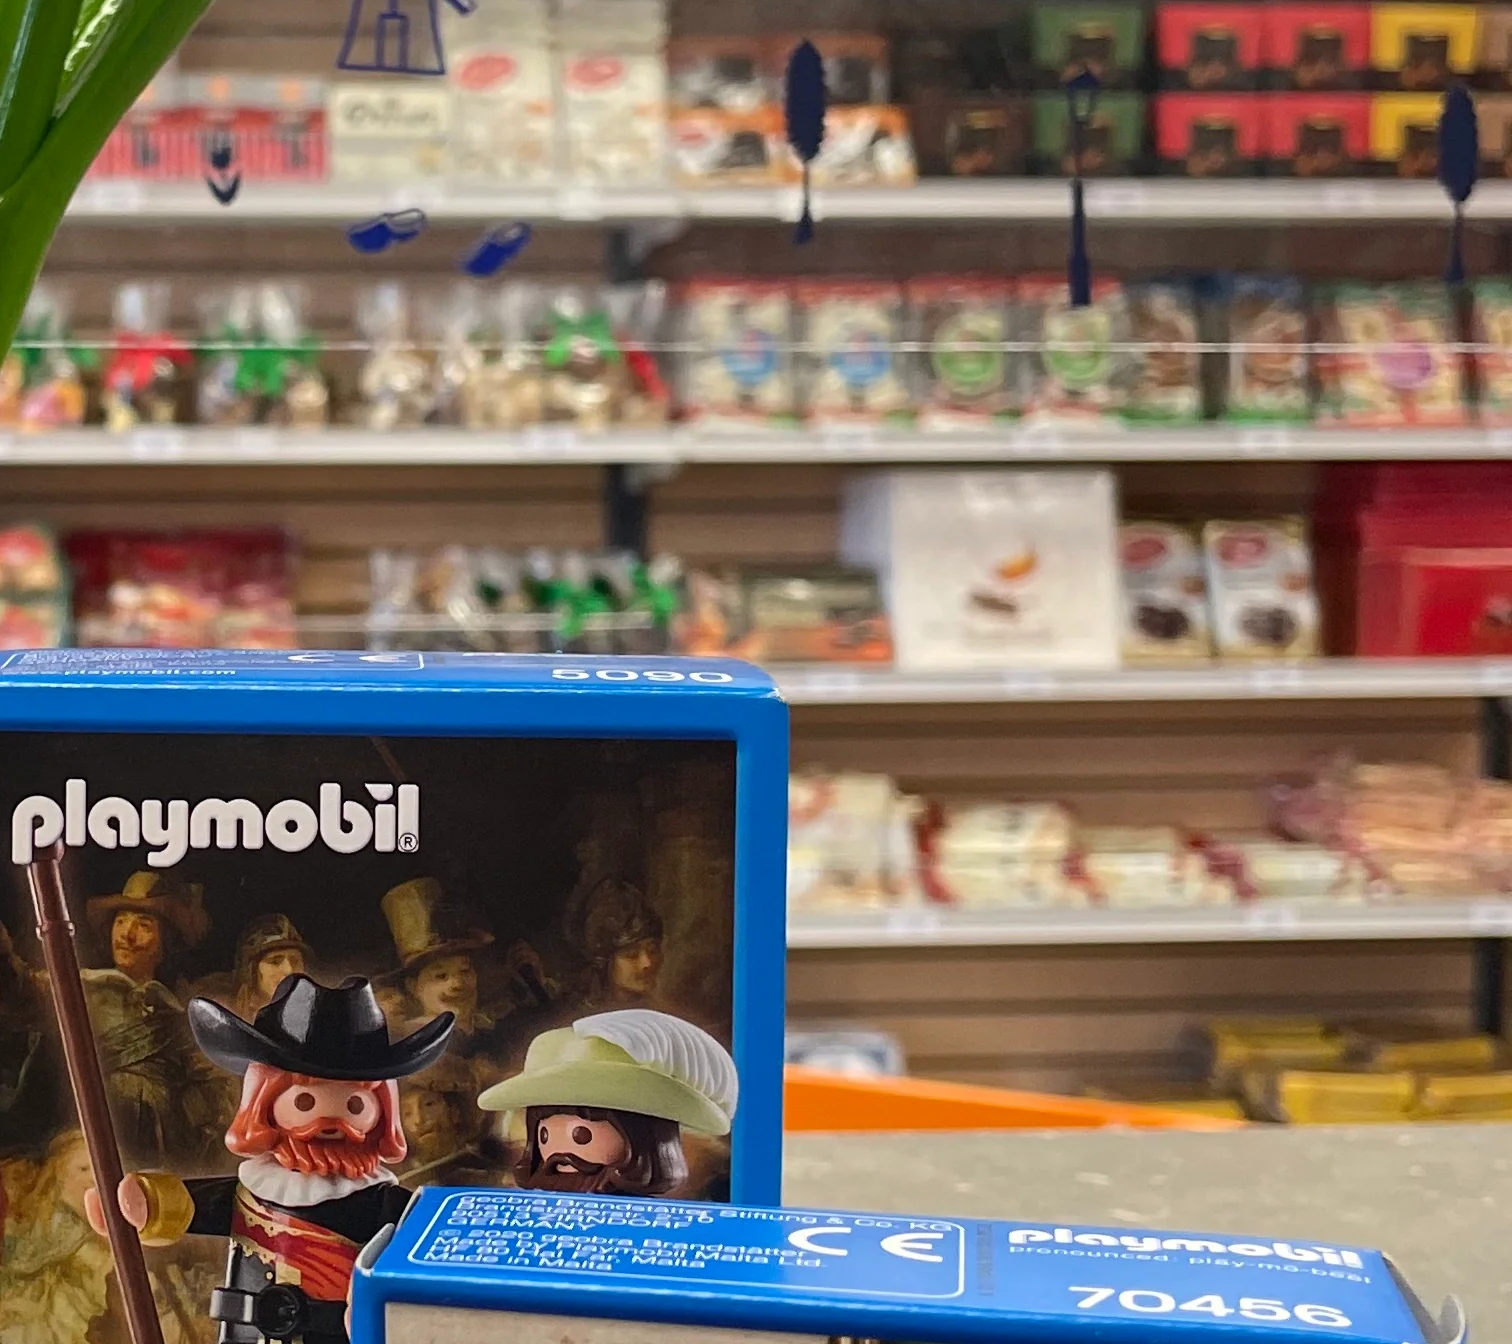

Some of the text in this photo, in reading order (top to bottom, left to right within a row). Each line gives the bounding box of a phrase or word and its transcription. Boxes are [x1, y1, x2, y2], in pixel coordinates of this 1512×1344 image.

[552, 669, 733, 682] 5090
[825, 1216, 844, 1224] &
[434, 1236, 507, 1247] Made
[555, 1242, 686, 1258] Playmobil
[694, 1251, 768, 1263] Malta
[1008, 1228, 1364, 1270] playmobil
[423, 1251, 500, 1264] Made
[537, 1258, 613, 1270] Malta
[630, 1255, 706, 1268] Malta
[1068, 1286, 1353, 1327] 70456
